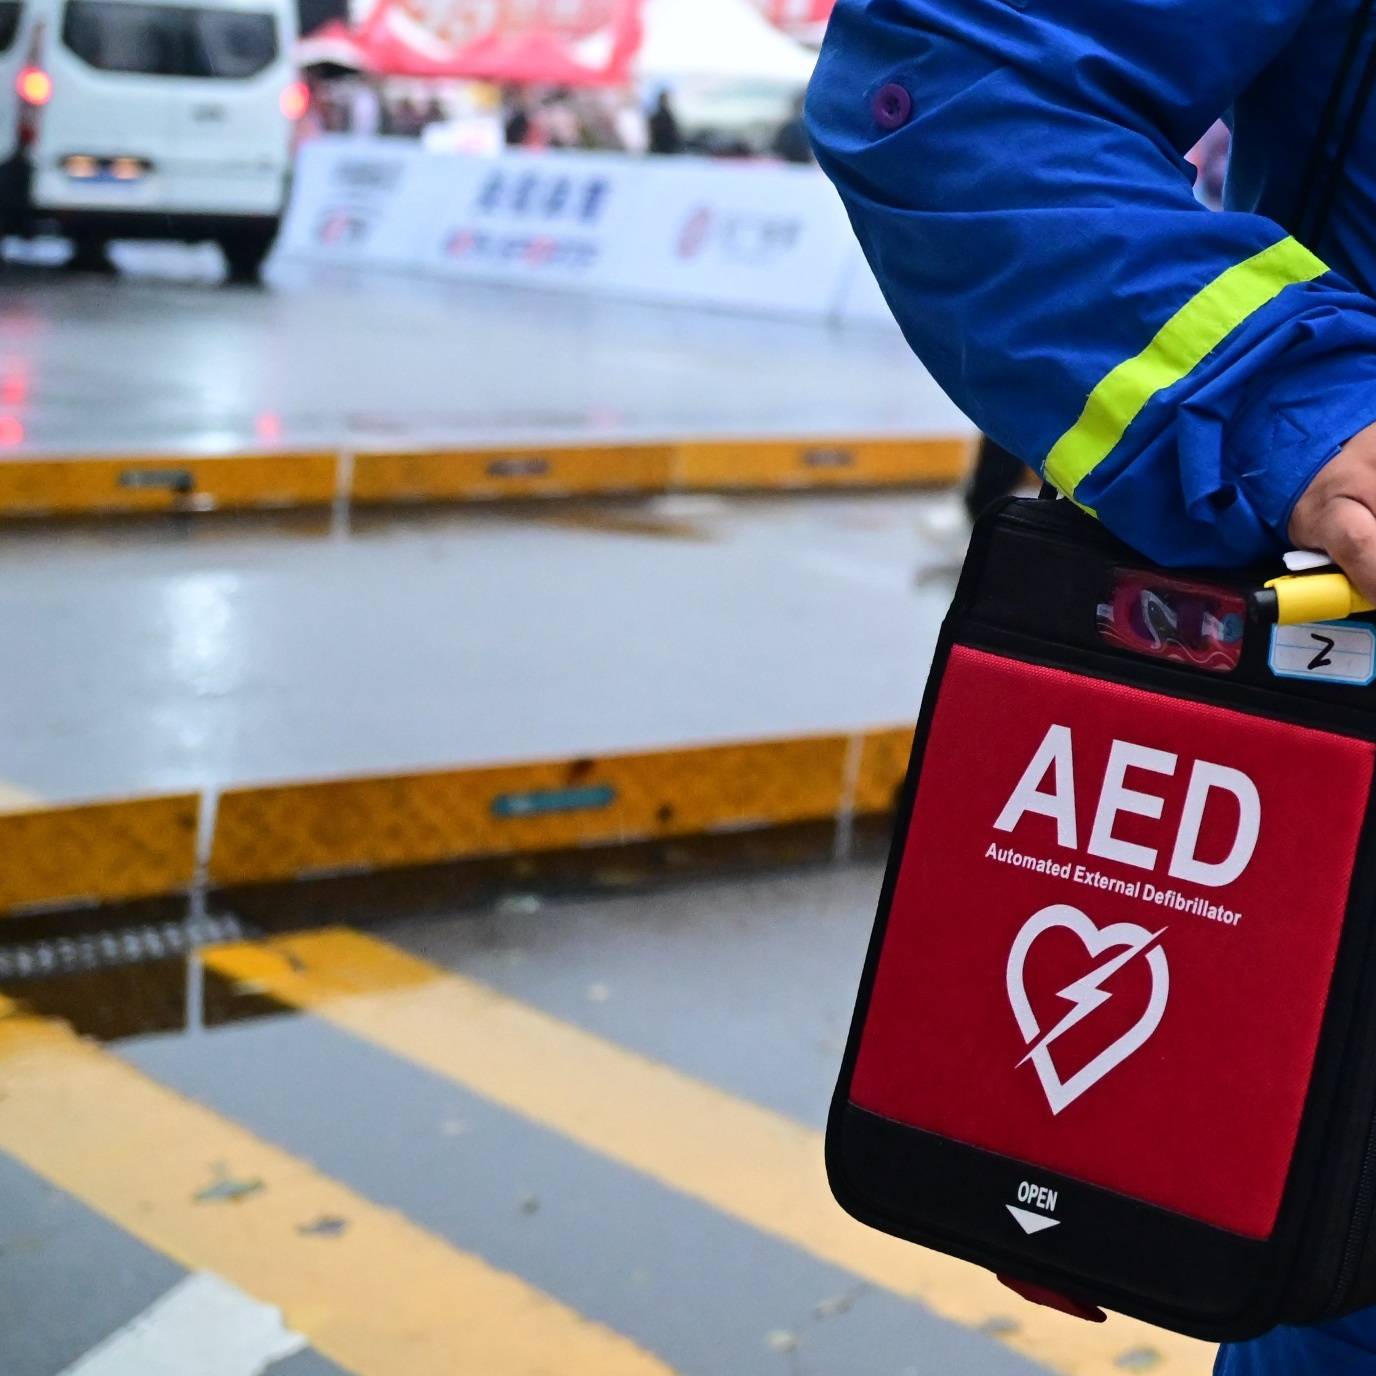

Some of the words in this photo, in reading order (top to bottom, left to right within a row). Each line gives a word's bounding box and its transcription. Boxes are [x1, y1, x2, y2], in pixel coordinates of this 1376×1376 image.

[992, 723, 1262, 888] AED
[985, 842, 1071, 879] Automated
[1073, 866, 1140, 898] External
[1142, 883, 1243, 926] Defibrillator
[1017, 1180, 1059, 1212] OPEN
